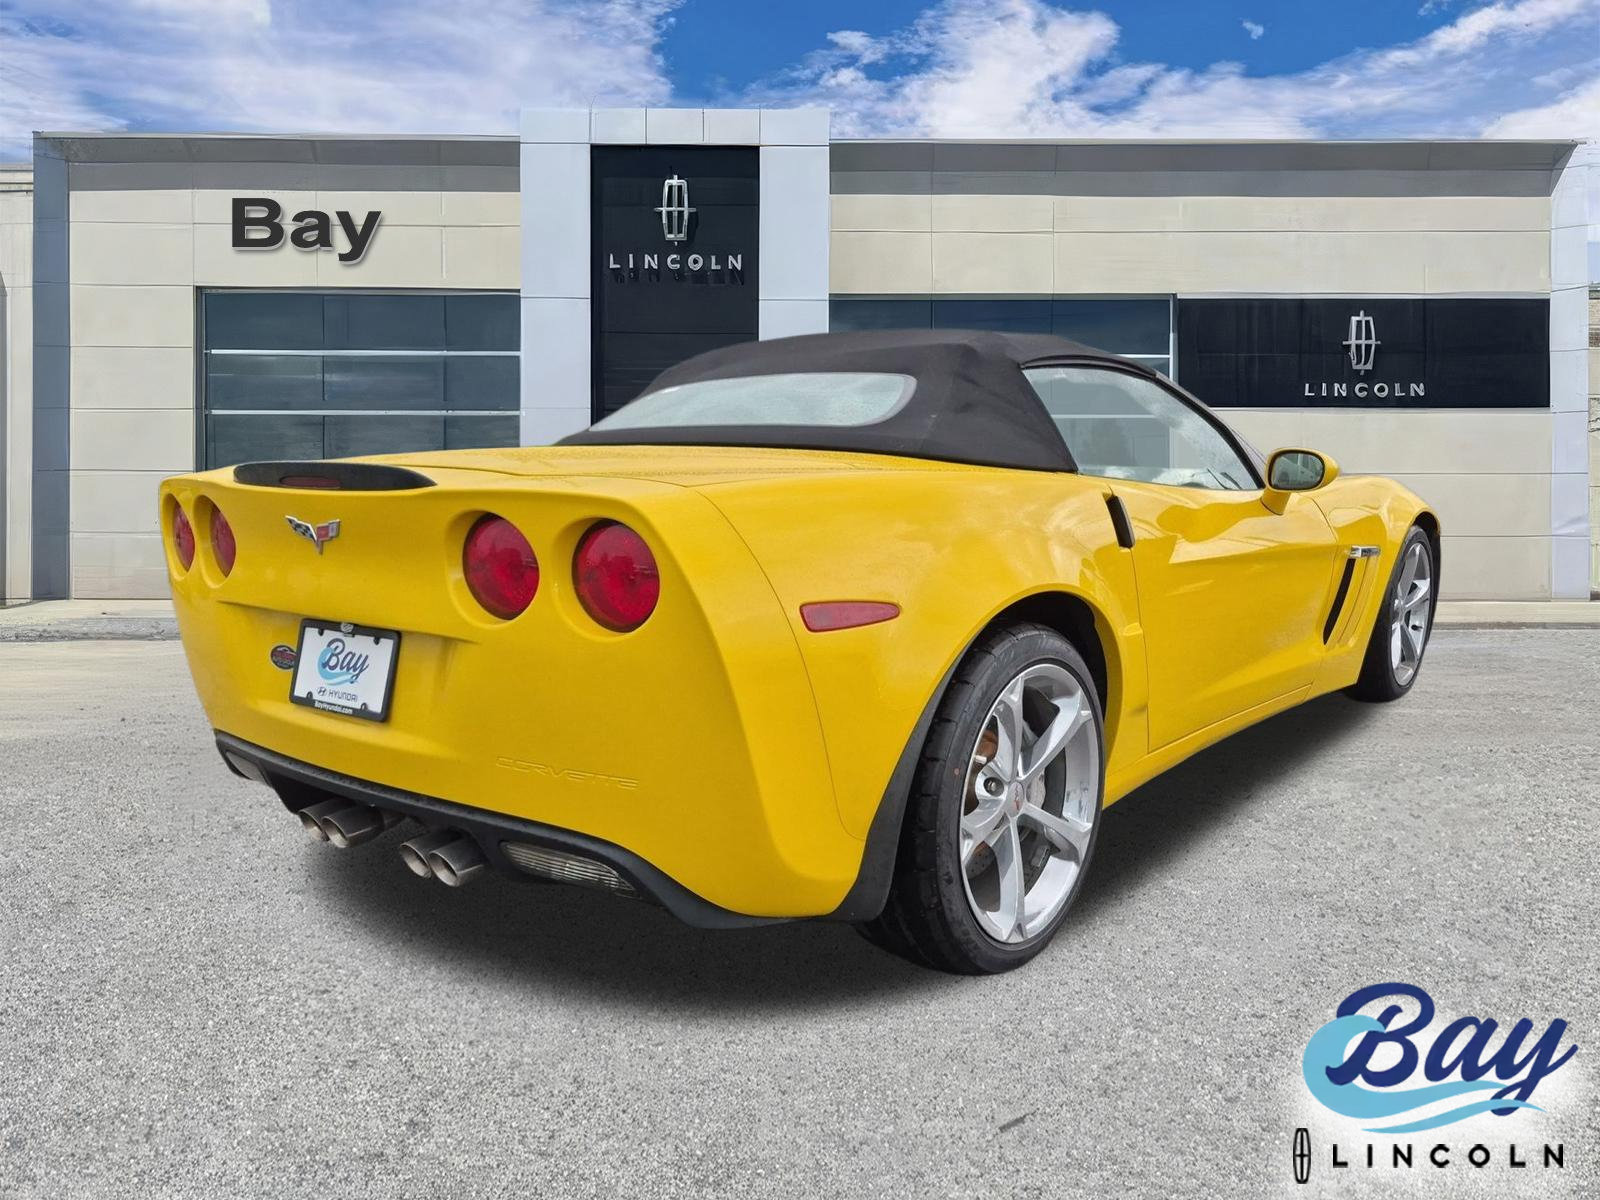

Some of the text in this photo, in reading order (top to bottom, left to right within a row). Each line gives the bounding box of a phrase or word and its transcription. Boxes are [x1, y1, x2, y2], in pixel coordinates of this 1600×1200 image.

[231, 197, 382, 263] Bay
[608, 253, 743, 271] LINCOLN
[1304, 382, 1425, 398] LINCOLN
[321, 637, 370, 684] Bay
[328, 688, 359, 702] HYUNDAI
[495, 755, 640, 791] CORVETTE
